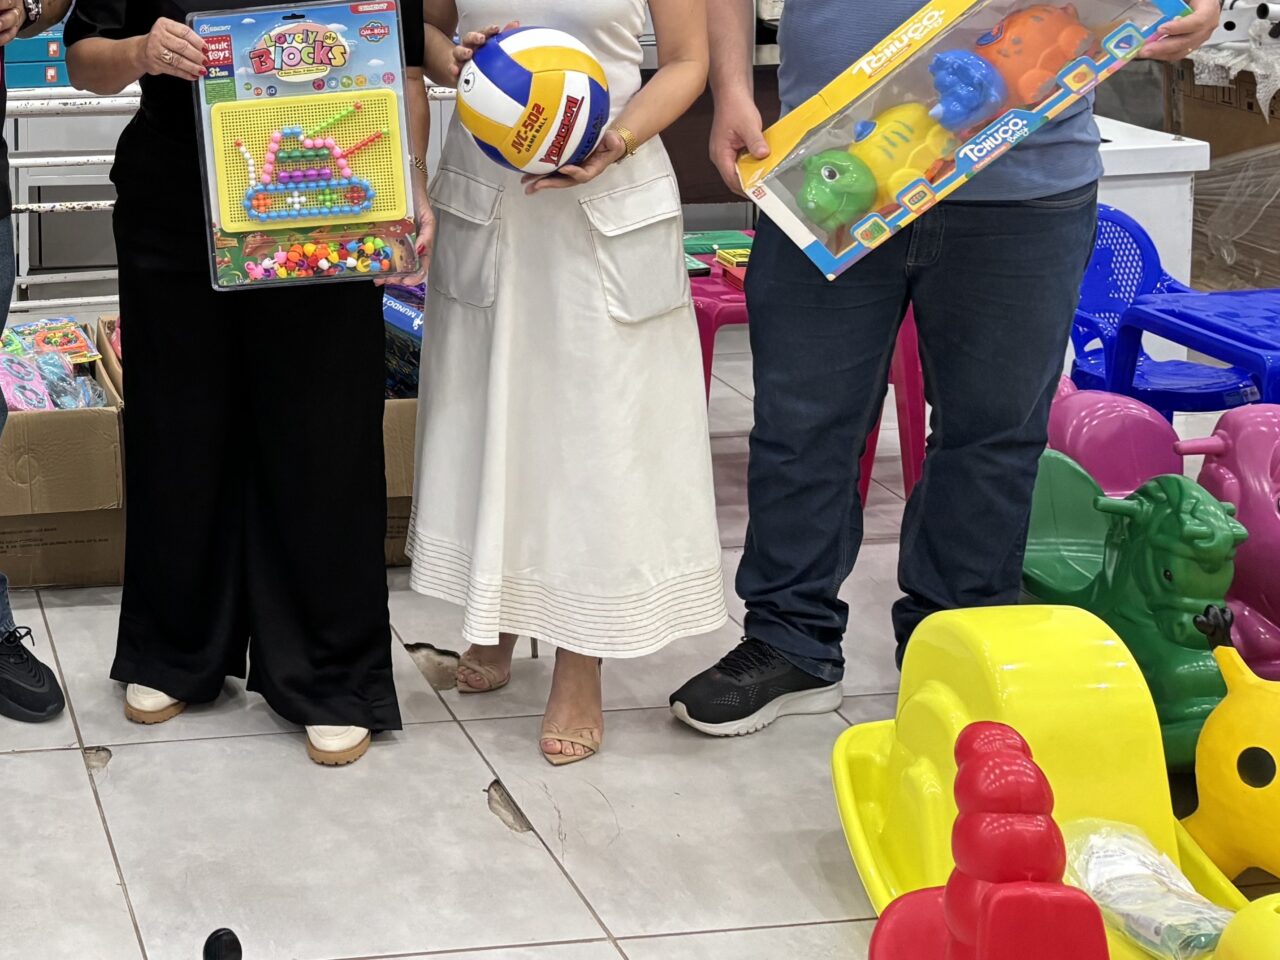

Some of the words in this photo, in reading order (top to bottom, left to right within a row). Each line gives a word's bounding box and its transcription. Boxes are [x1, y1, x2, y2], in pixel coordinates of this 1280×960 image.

[208, 41, 228, 50] lassic
[263, 29, 318, 47] Lovely
[511, 103, 546, 154] JVC-502
[525, 133, 538, 152] GAME
[536, 117, 548, 135] BALL
[387, 300, 417, 318] MUNDO
